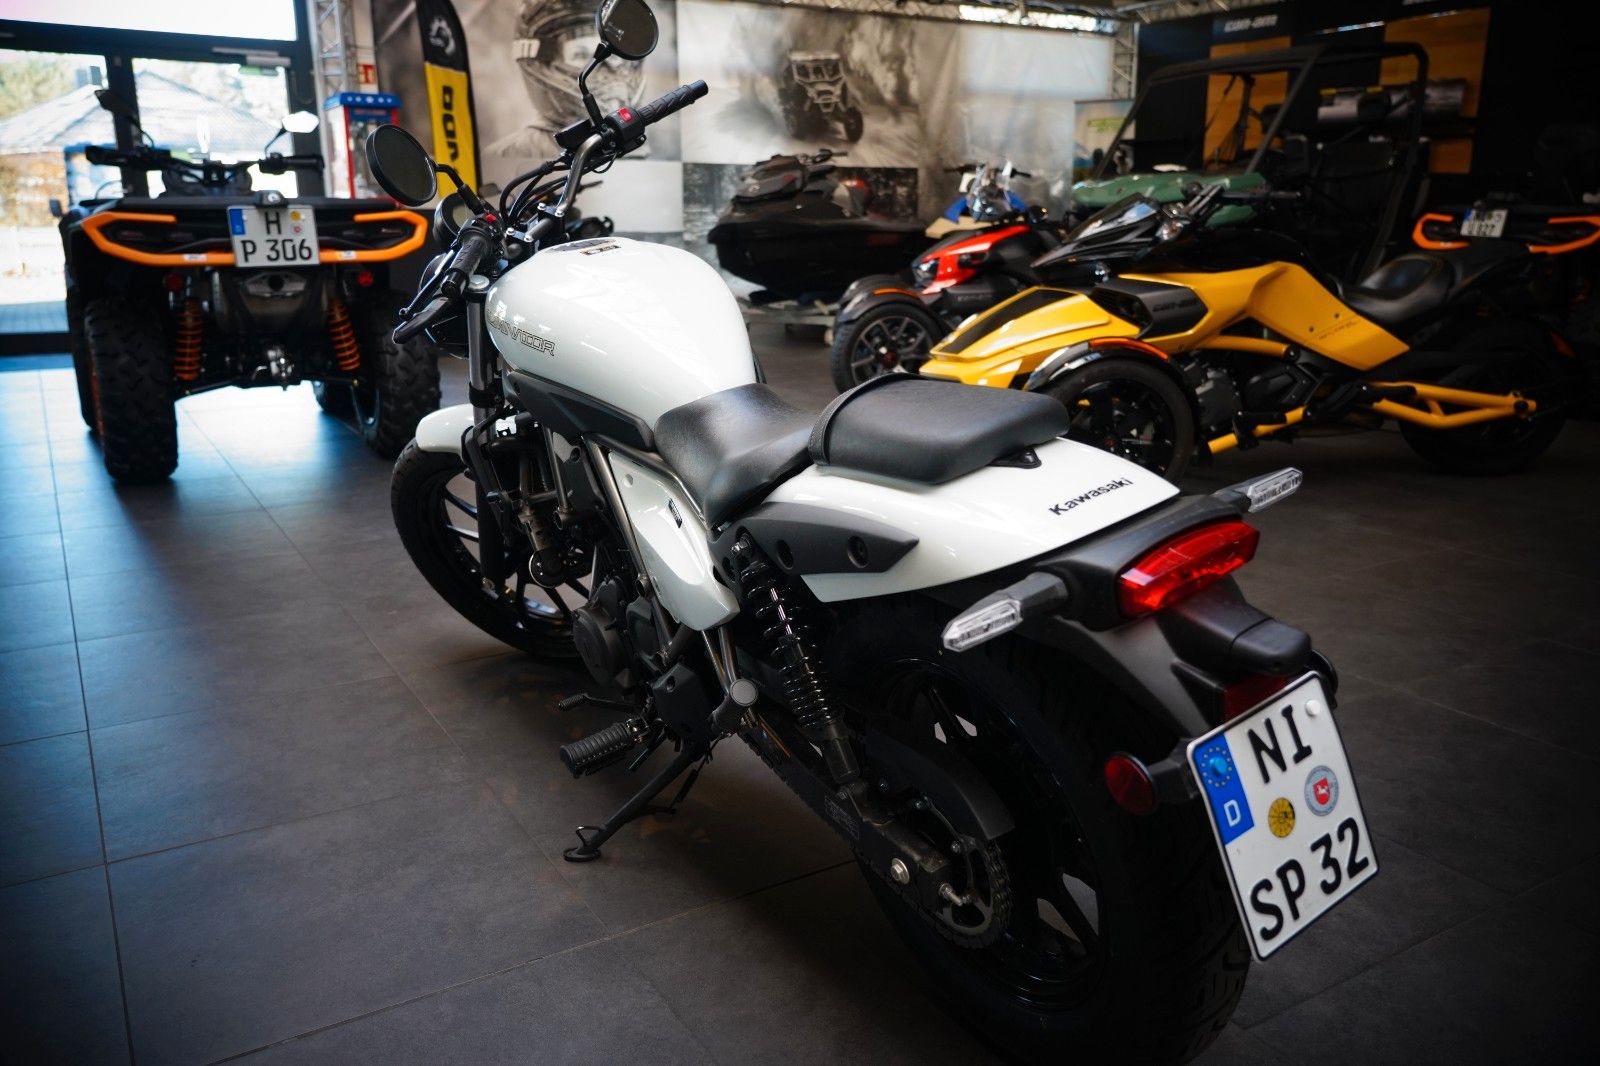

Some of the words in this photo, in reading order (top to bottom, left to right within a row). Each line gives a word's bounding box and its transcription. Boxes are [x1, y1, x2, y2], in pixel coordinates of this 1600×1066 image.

[264, 211, 282, 235] H
[240, 239, 257, 263] P
[265, 238, 313, 262] 306
[1048, 477, 1134, 516] Kawasaki
[1247, 703, 1313, 785] NI
[1223, 798, 1242, 829] D
[1250, 857, 1306, 943] SP
[1310, 816, 1370, 897] 32
